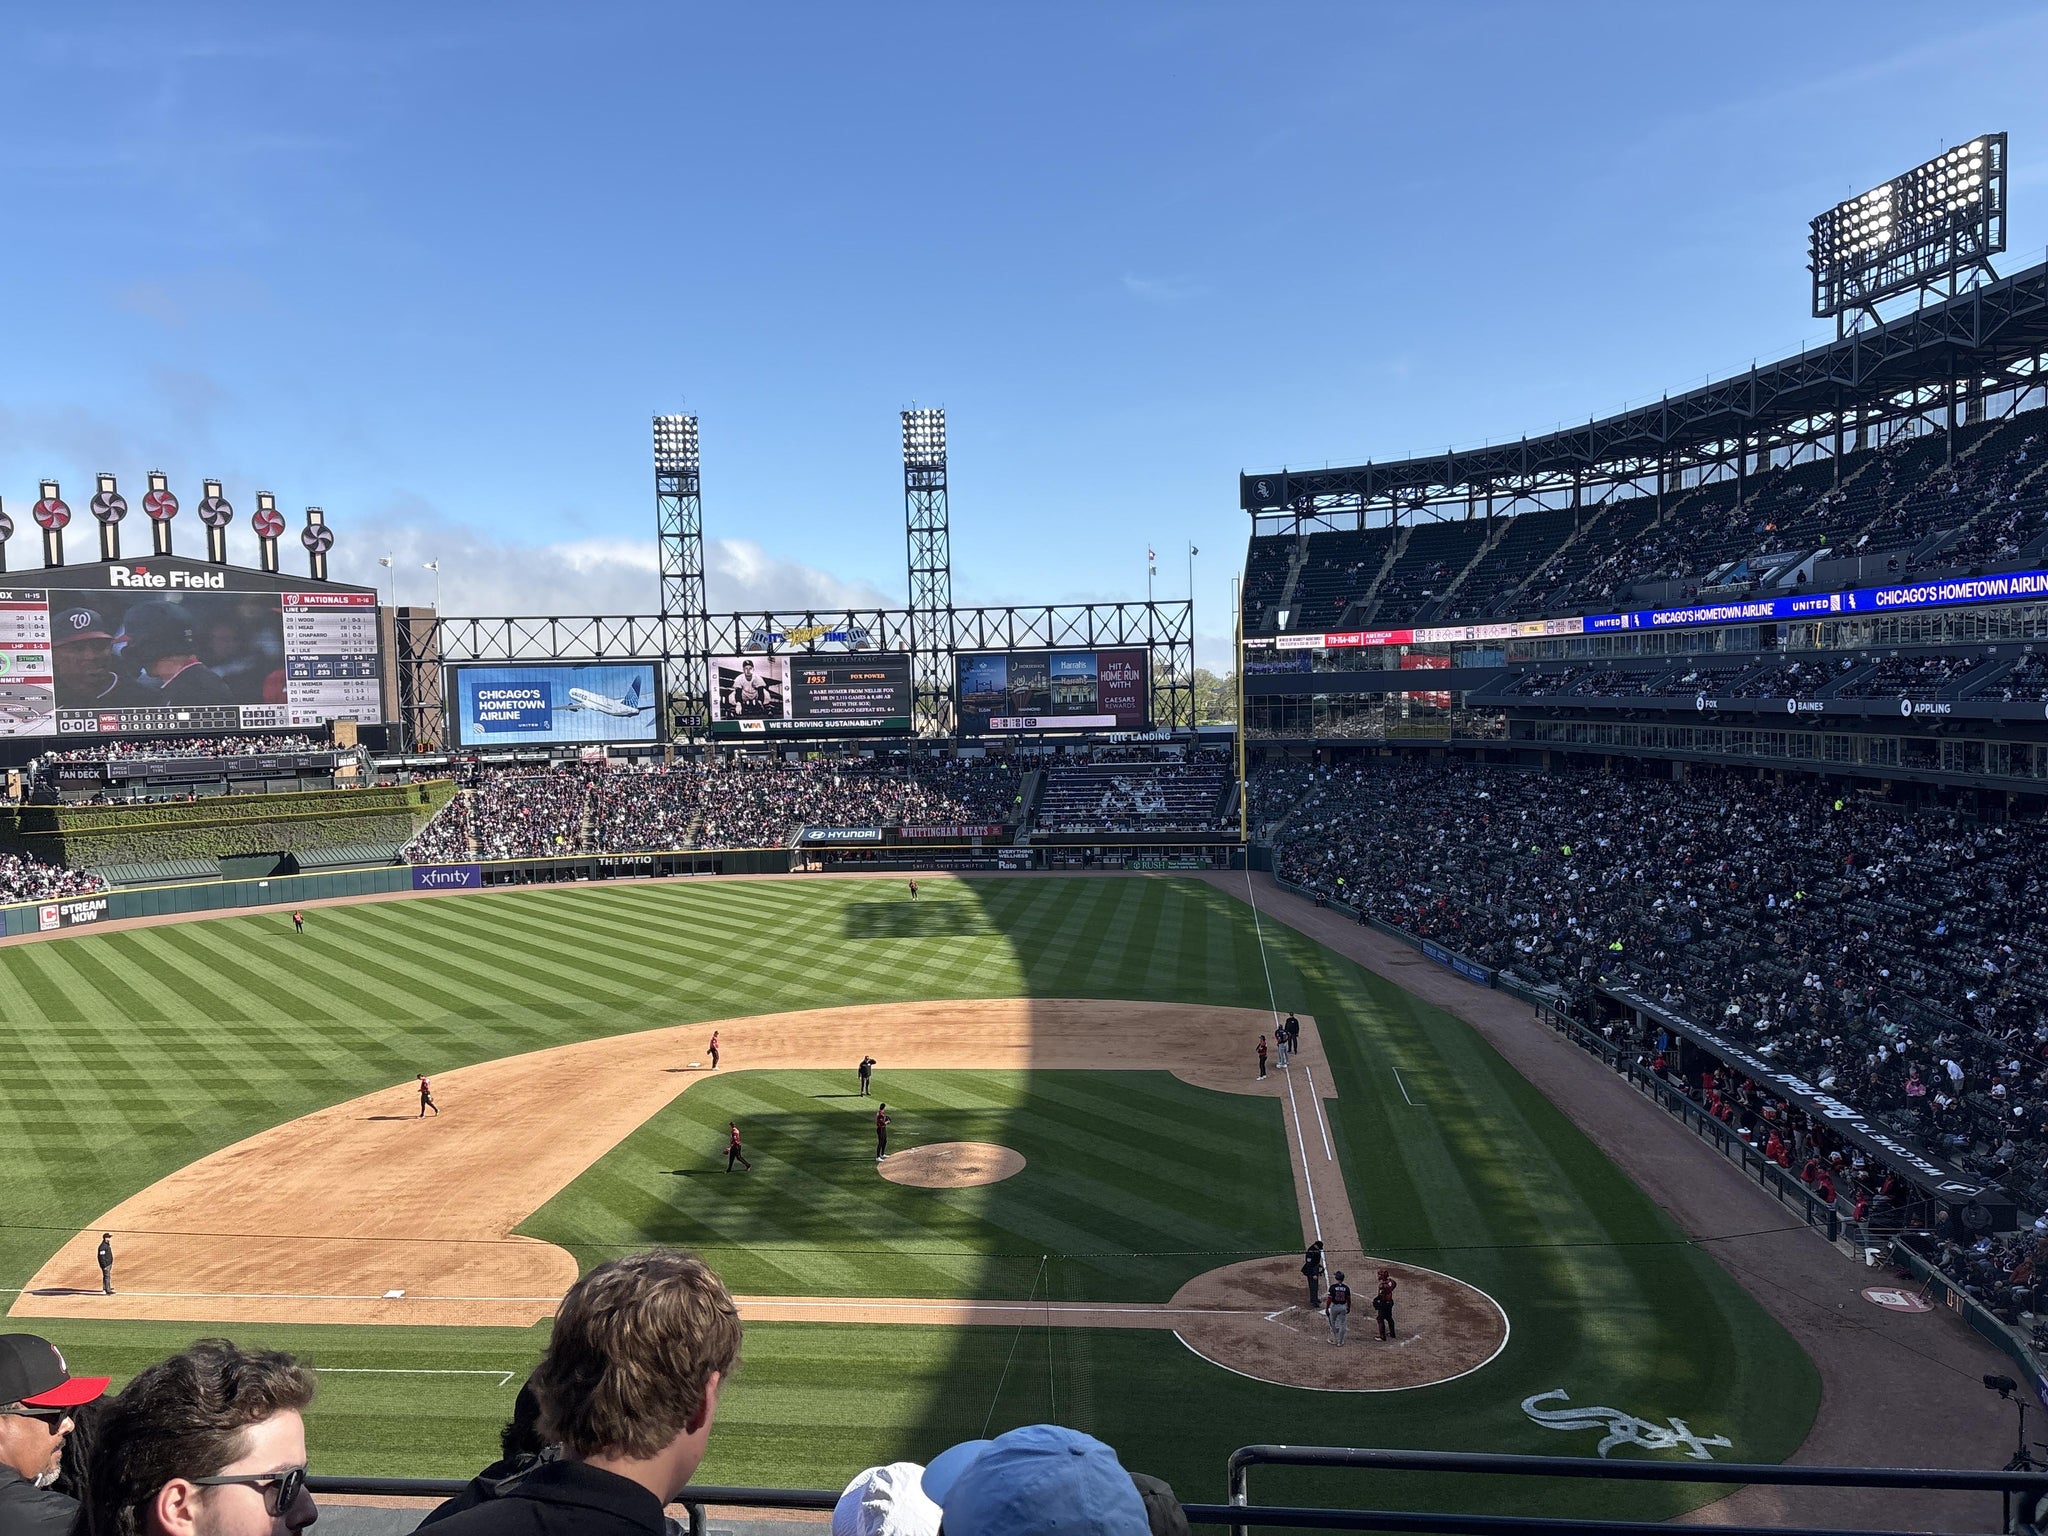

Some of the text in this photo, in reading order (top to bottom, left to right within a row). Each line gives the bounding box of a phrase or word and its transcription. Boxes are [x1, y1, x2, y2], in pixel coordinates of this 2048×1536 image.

[110, 566, 225, 589] Rate Field
[1876, 586, 1937, 606] CHICAGO'S
[1939, 580, 2008, 602] HOMETOWN
[304, 596, 349, 604] NATIONALS
[1792, 600, 1829, 611] UNITED
[1652, 612, 1694, 626] CHICAGO'S
[1694, 606, 1742, 622] HOMETOWN
[1594, 618, 1620, 628] UNITED
[783, 624, 834, 648] Miller
[824, 632, 848, 642] TIME
[849, 630, 866, 643] Lite
[1060, 661, 1087, 670] Harrah's
[1124, 662, 1132, 670] A
[806, 676, 826, 684] 1953
[1101, 670, 1140, 681] HOME RUN
[1110, 681, 1131, 689] WITH
[478, 689, 540, 699] CHICAGO'S
[479, 700, 545, 710] HOMETOWN
[1705, 700, 1718, 709] FOX
[1797, 702, 1823, 711] BAINES
[1914, 703, 1950, 714] APPLING
[480, 711, 521, 721] AIRLINE
[87, 721, 95, 730] 2
[1130, 733, 1171, 741] LANDING
[60, 770, 100, 779] FAN DECK
[828, 830, 876, 839] HYUNDAI
[901, 826, 988, 838] WHITTINGHAM MEATS
[621, 856, 652, 865] PATIO
[998, 861, 1017, 869] Rate
[421, 870, 470, 886] xfinity
[60, 899, 107, 915] STREAM
[72, 910, 97, 924] NOW
[1668, 1015, 1711, 1036] CHICAGO
[1704, 1036, 1730, 1047] THE
[1723, 1046, 1744, 1054] OF
[1736, 1055, 1774, 1072] HOME
[1766, 1074, 1826, 1096] Field
[1813, 1096, 1865, 1119] Rate
[1851, 1122, 1876, 1134] TO
[1868, 1134, 1944, 1176] WELCOME
[1521, 1388, 1733, 1460] Sox
